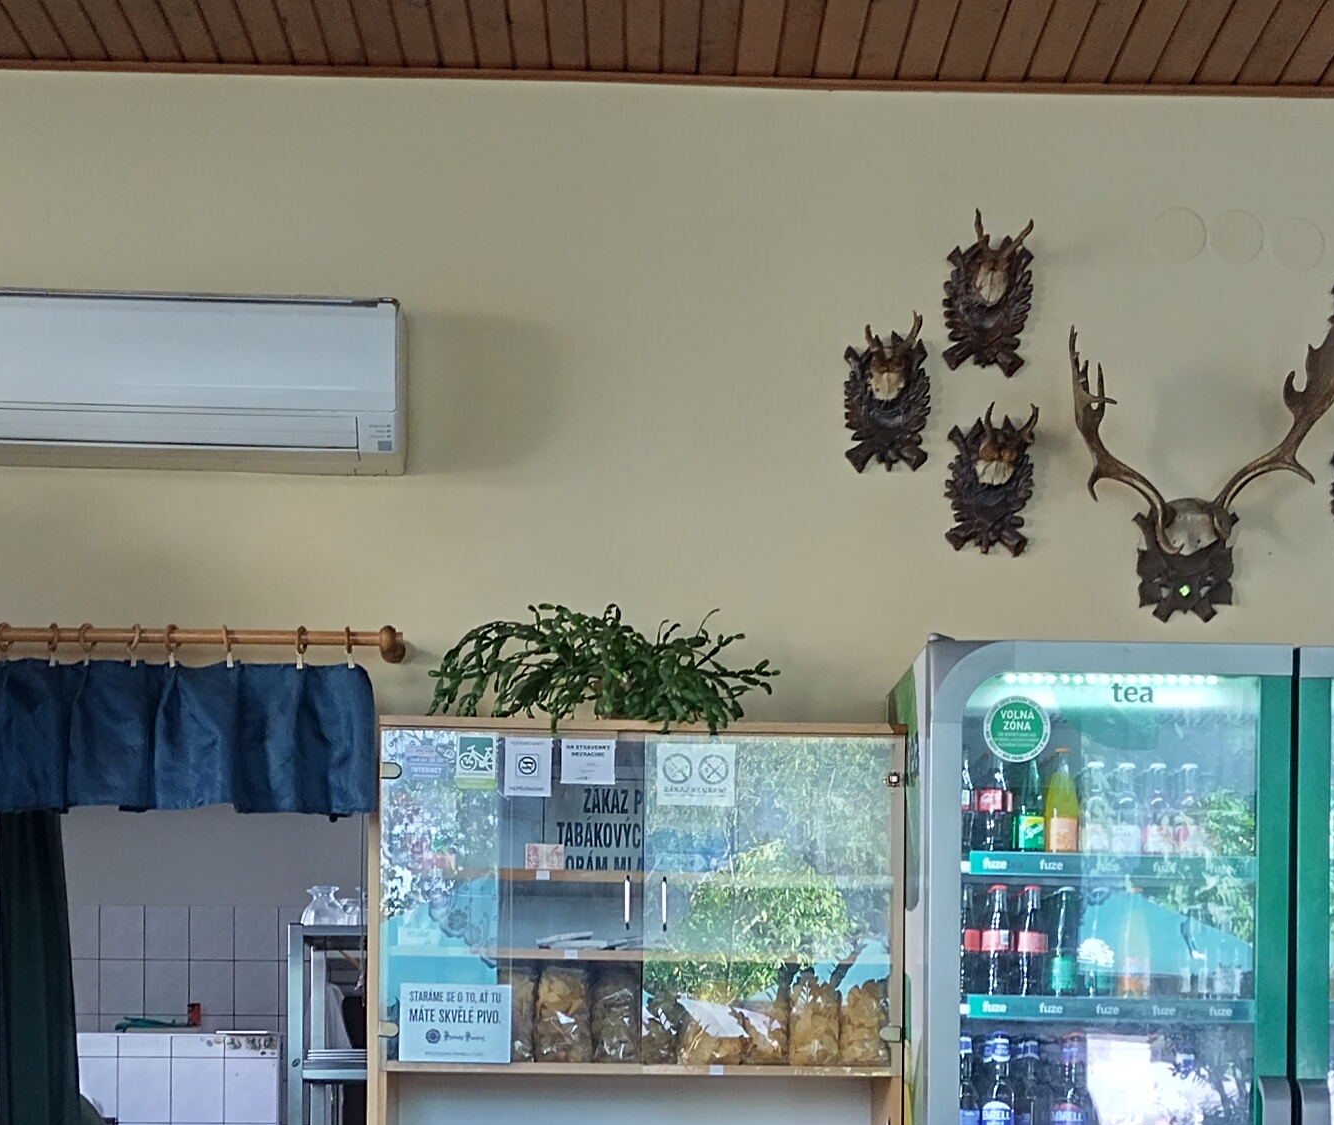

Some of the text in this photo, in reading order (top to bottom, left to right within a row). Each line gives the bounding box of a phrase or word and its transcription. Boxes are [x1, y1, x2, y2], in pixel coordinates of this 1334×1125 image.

[1111, 682, 1153, 703] tea
[1000, 708, 1035, 720] VOLNÁ
[1003, 719, 1031, 731] ZÓNA
[583, 785, 628, 815] ZÁKAZ
[556, 816, 642, 849] TABÁKOVÝC
[982, 857, 1007, 870] fuze
[1039, 859, 1064, 871] fuze
[409, 989, 444, 1003] STARÁME
[447, 992, 455, 1003] SE
[457, 992, 463, 1003] O
[465, 992, 478, 1005] TO,
[491, 992, 501, 1004] TU
[409, 1005, 502, 1025] MÁTE SKVĚLÉ PIVO.
[982, 1001, 1233, 1018] fuze fuze fuze fuze fuze
